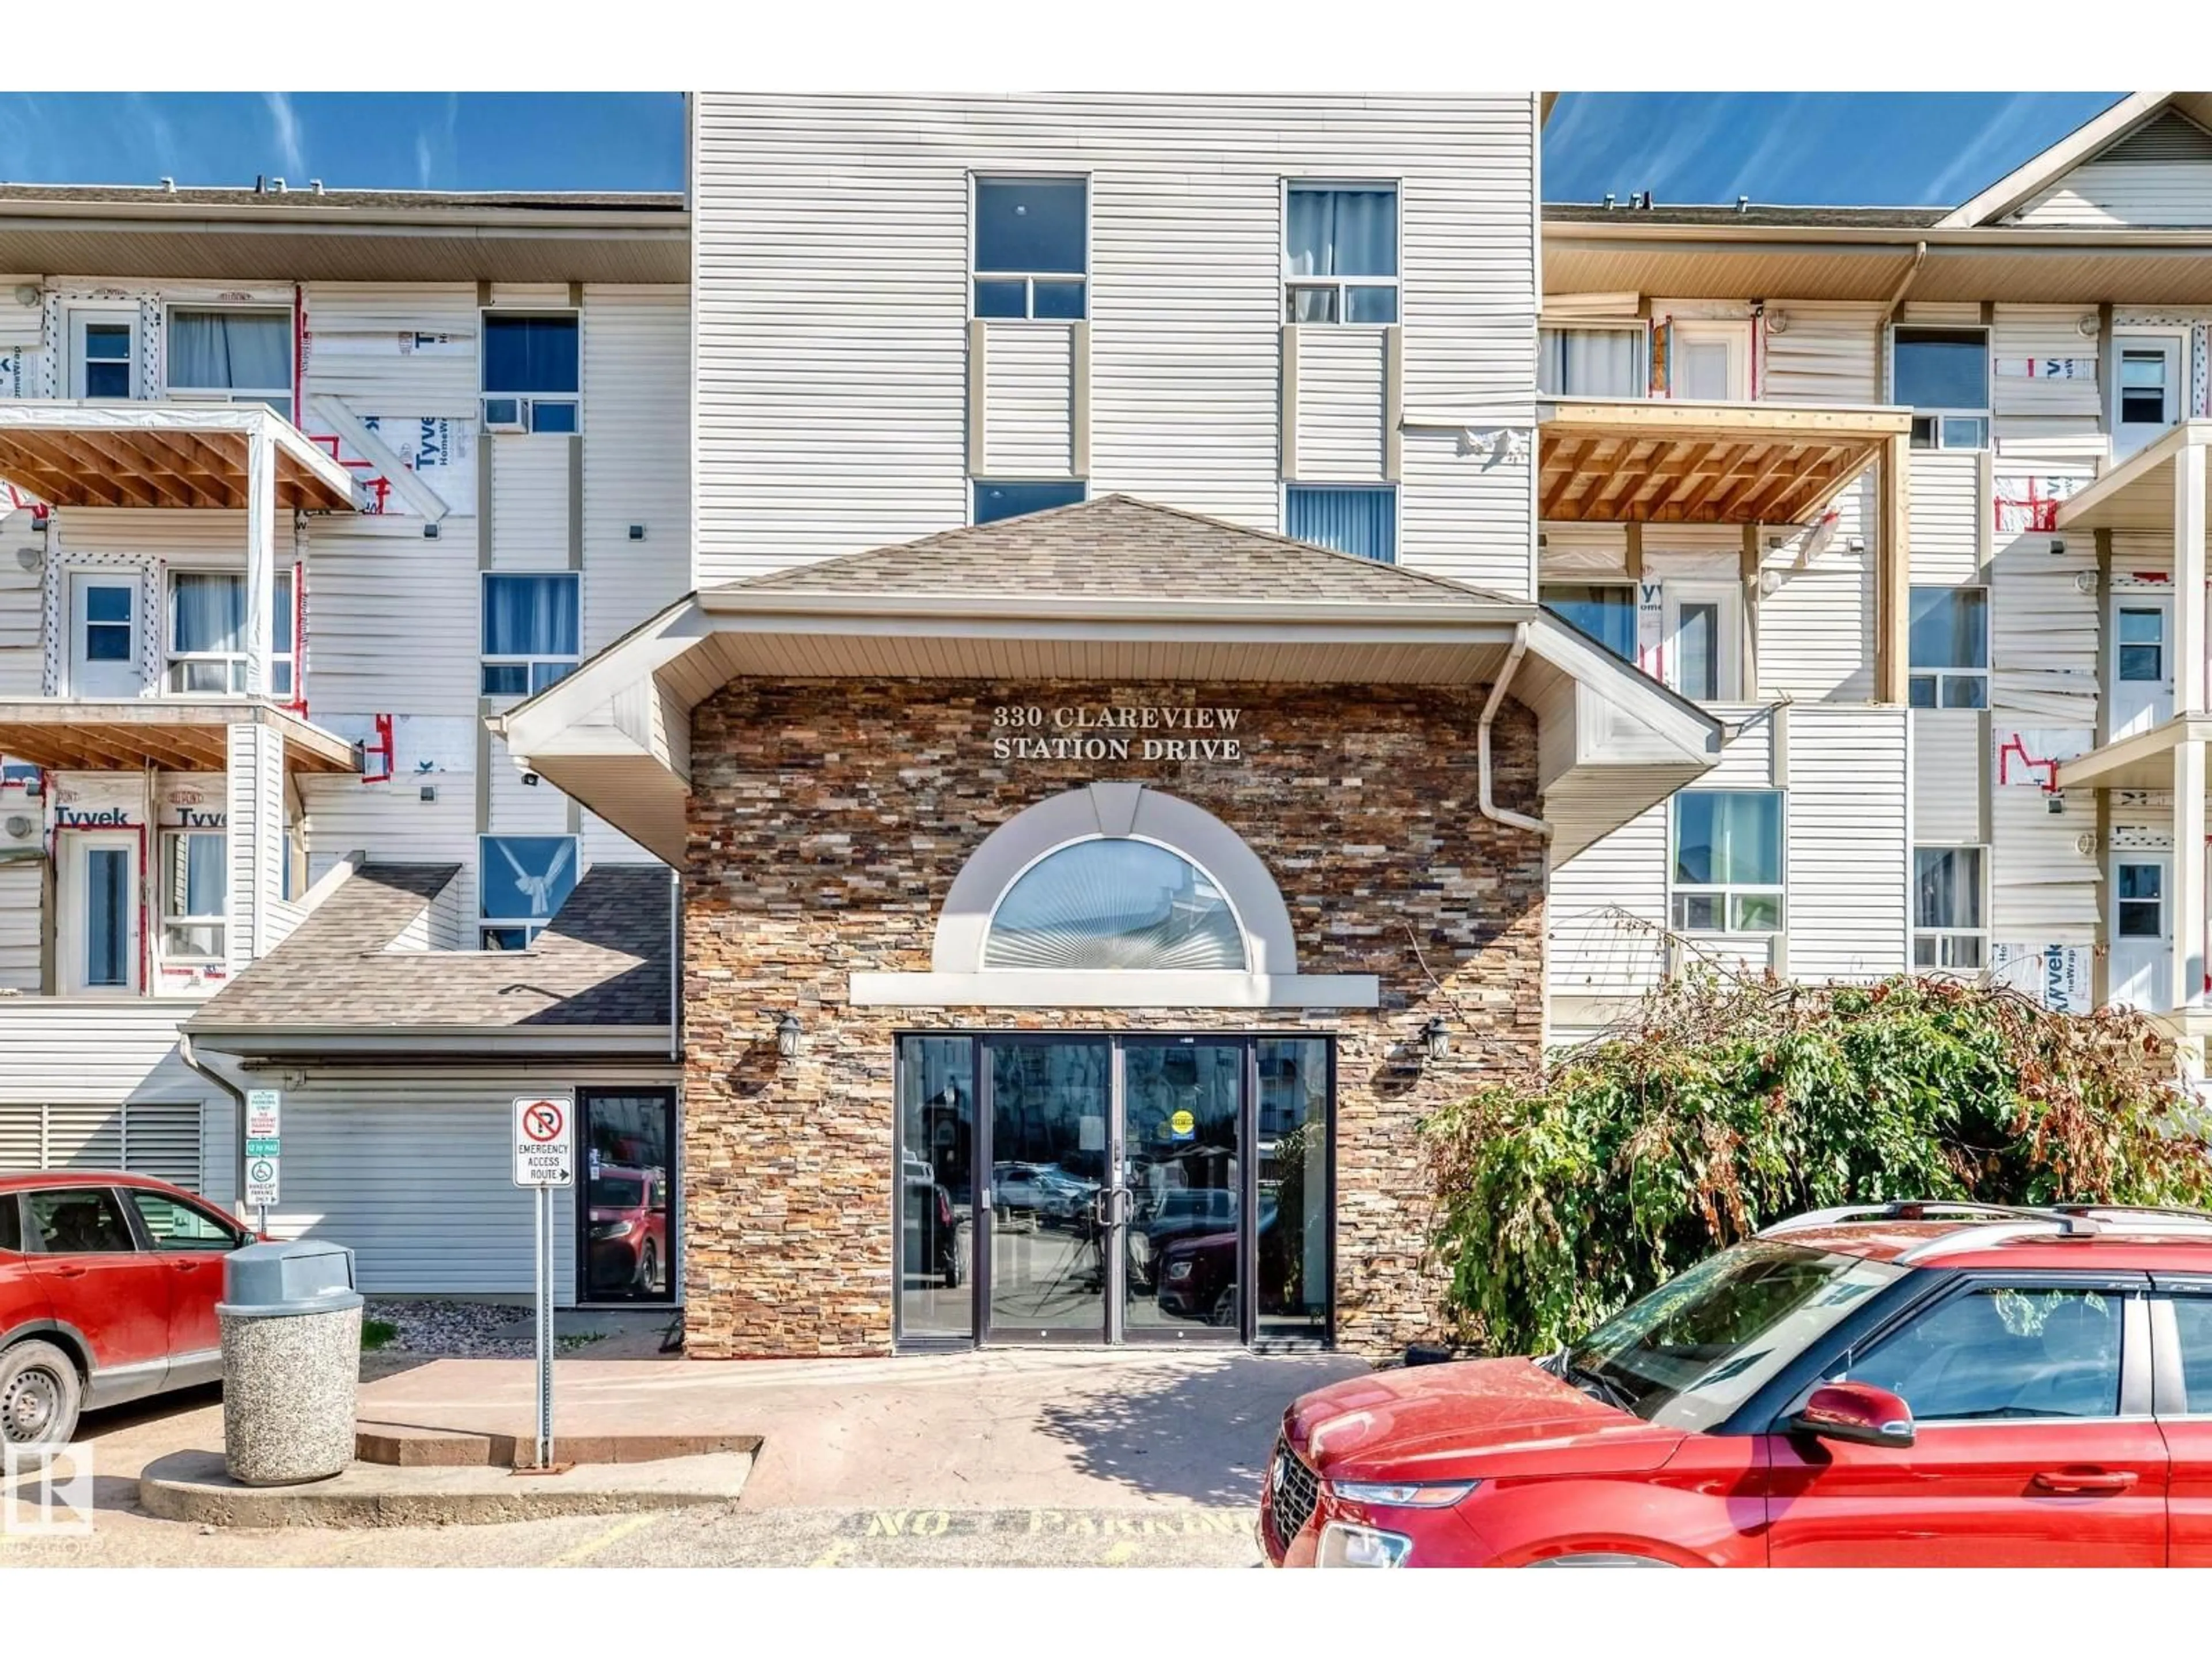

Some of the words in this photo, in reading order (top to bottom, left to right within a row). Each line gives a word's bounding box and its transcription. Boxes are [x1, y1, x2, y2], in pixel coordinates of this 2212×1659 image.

[416, 417, 440, 471] Tyve
[994, 707, 1042, 727] 330
[1054, 707, 1241, 730] CLAREVIEW
[994, 738, 1130, 760] STATION
[1141, 739, 1241, 760] DRIVE
[55, 807, 128, 828] Tyvek
[518, 1145, 569, 1154] EMERGENCY
[528, 1157, 559, 1166] ACCESS
[531, 1169, 557, 1179] ROUTE
[866, 1510, 952, 1537] NO
